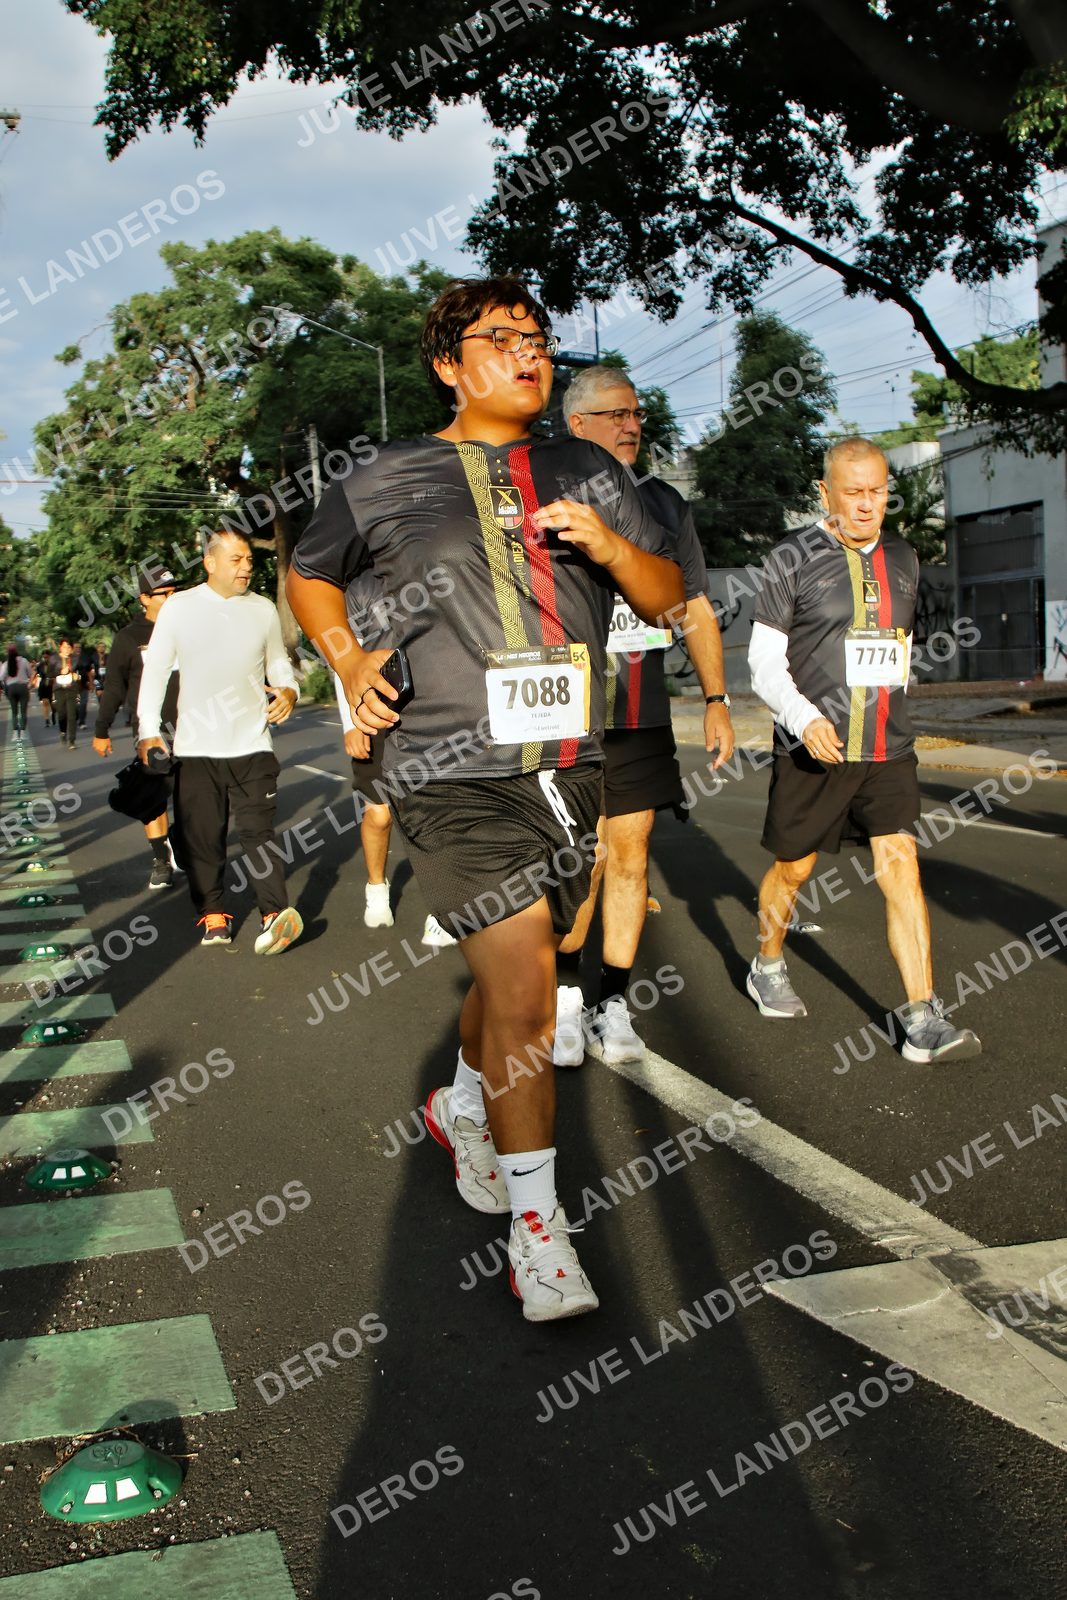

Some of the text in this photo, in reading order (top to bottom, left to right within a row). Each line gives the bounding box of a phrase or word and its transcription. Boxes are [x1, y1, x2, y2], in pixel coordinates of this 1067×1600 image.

[573, 651, 586, 662] 5K
[856, 647, 897, 665] 7774
[502, 675, 571, 709] 7088
